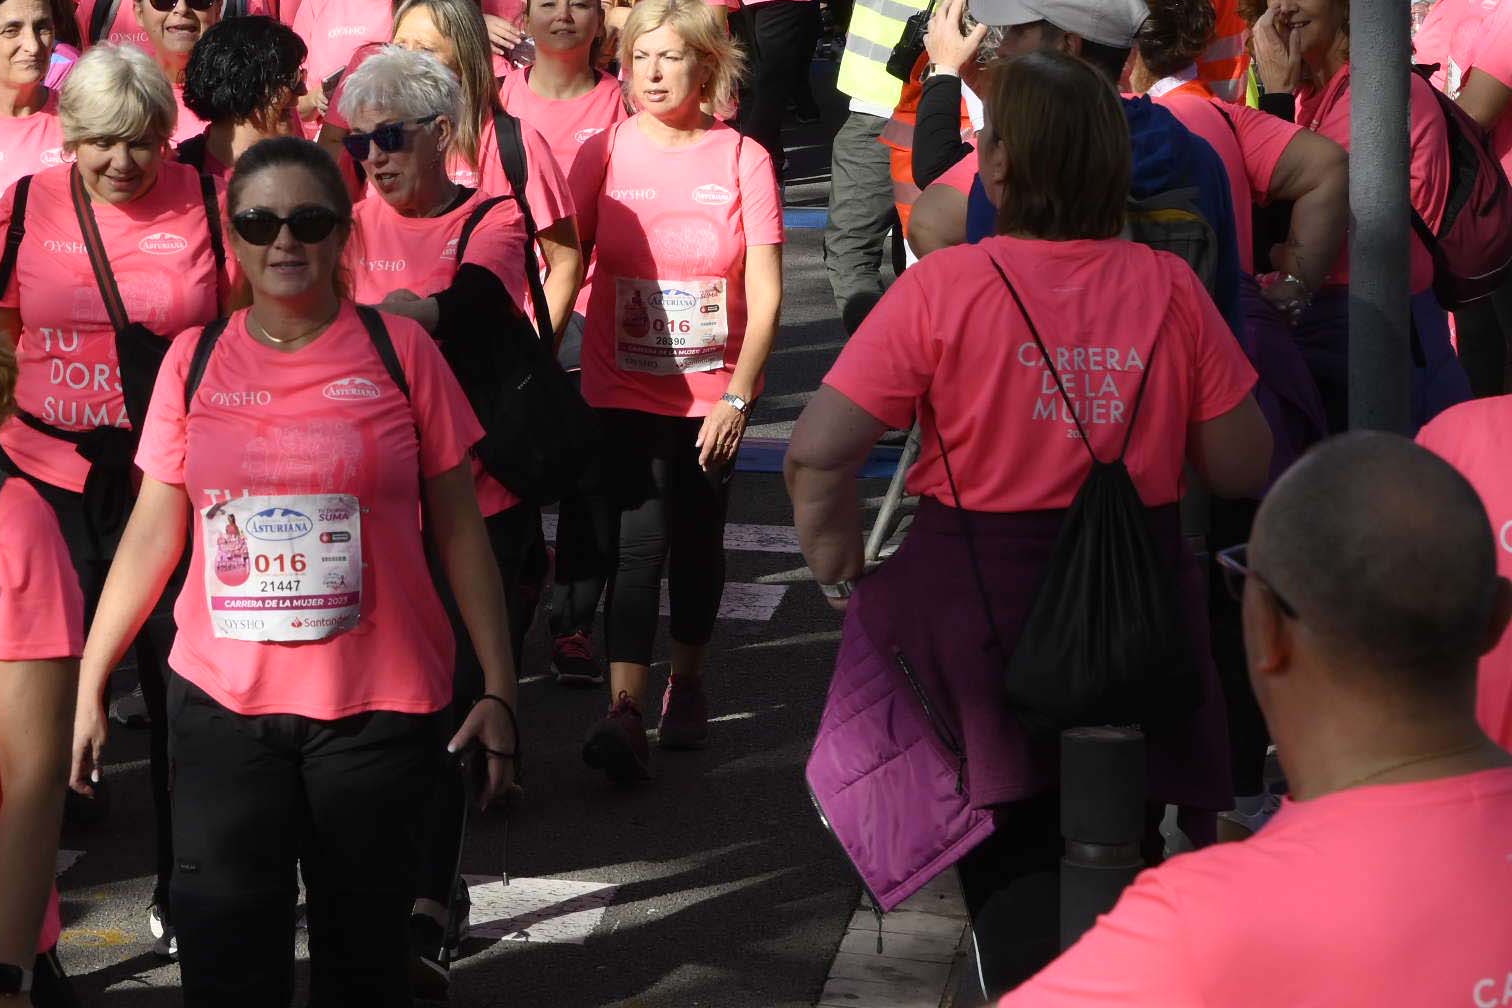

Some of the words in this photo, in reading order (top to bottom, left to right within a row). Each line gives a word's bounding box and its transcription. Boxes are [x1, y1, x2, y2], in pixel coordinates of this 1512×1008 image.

[363, 258, 408, 273] YSHO
[652, 319, 691, 334] 016
[39, 327, 80, 353] TU
[656, 336, 686, 346] 28390
[50, 358, 123, 392] DORS
[1041, 370, 1076, 397] DE
[1084, 374, 1120, 397] LA
[42, 396, 134, 428] SUMA
[1032, 396, 1126, 424] MUJER
[319, 511, 350, 522] SUMA
[252, 520, 309, 534] ASTURIANA
[254, 552, 307, 574] 016
[260, 580, 302, 593] 21447
[224, 598, 264, 609] CARRERA
[265, 599, 278, 609] DE
[279, 598, 291, 608] LA
[292, 597, 325, 608] MUJER
